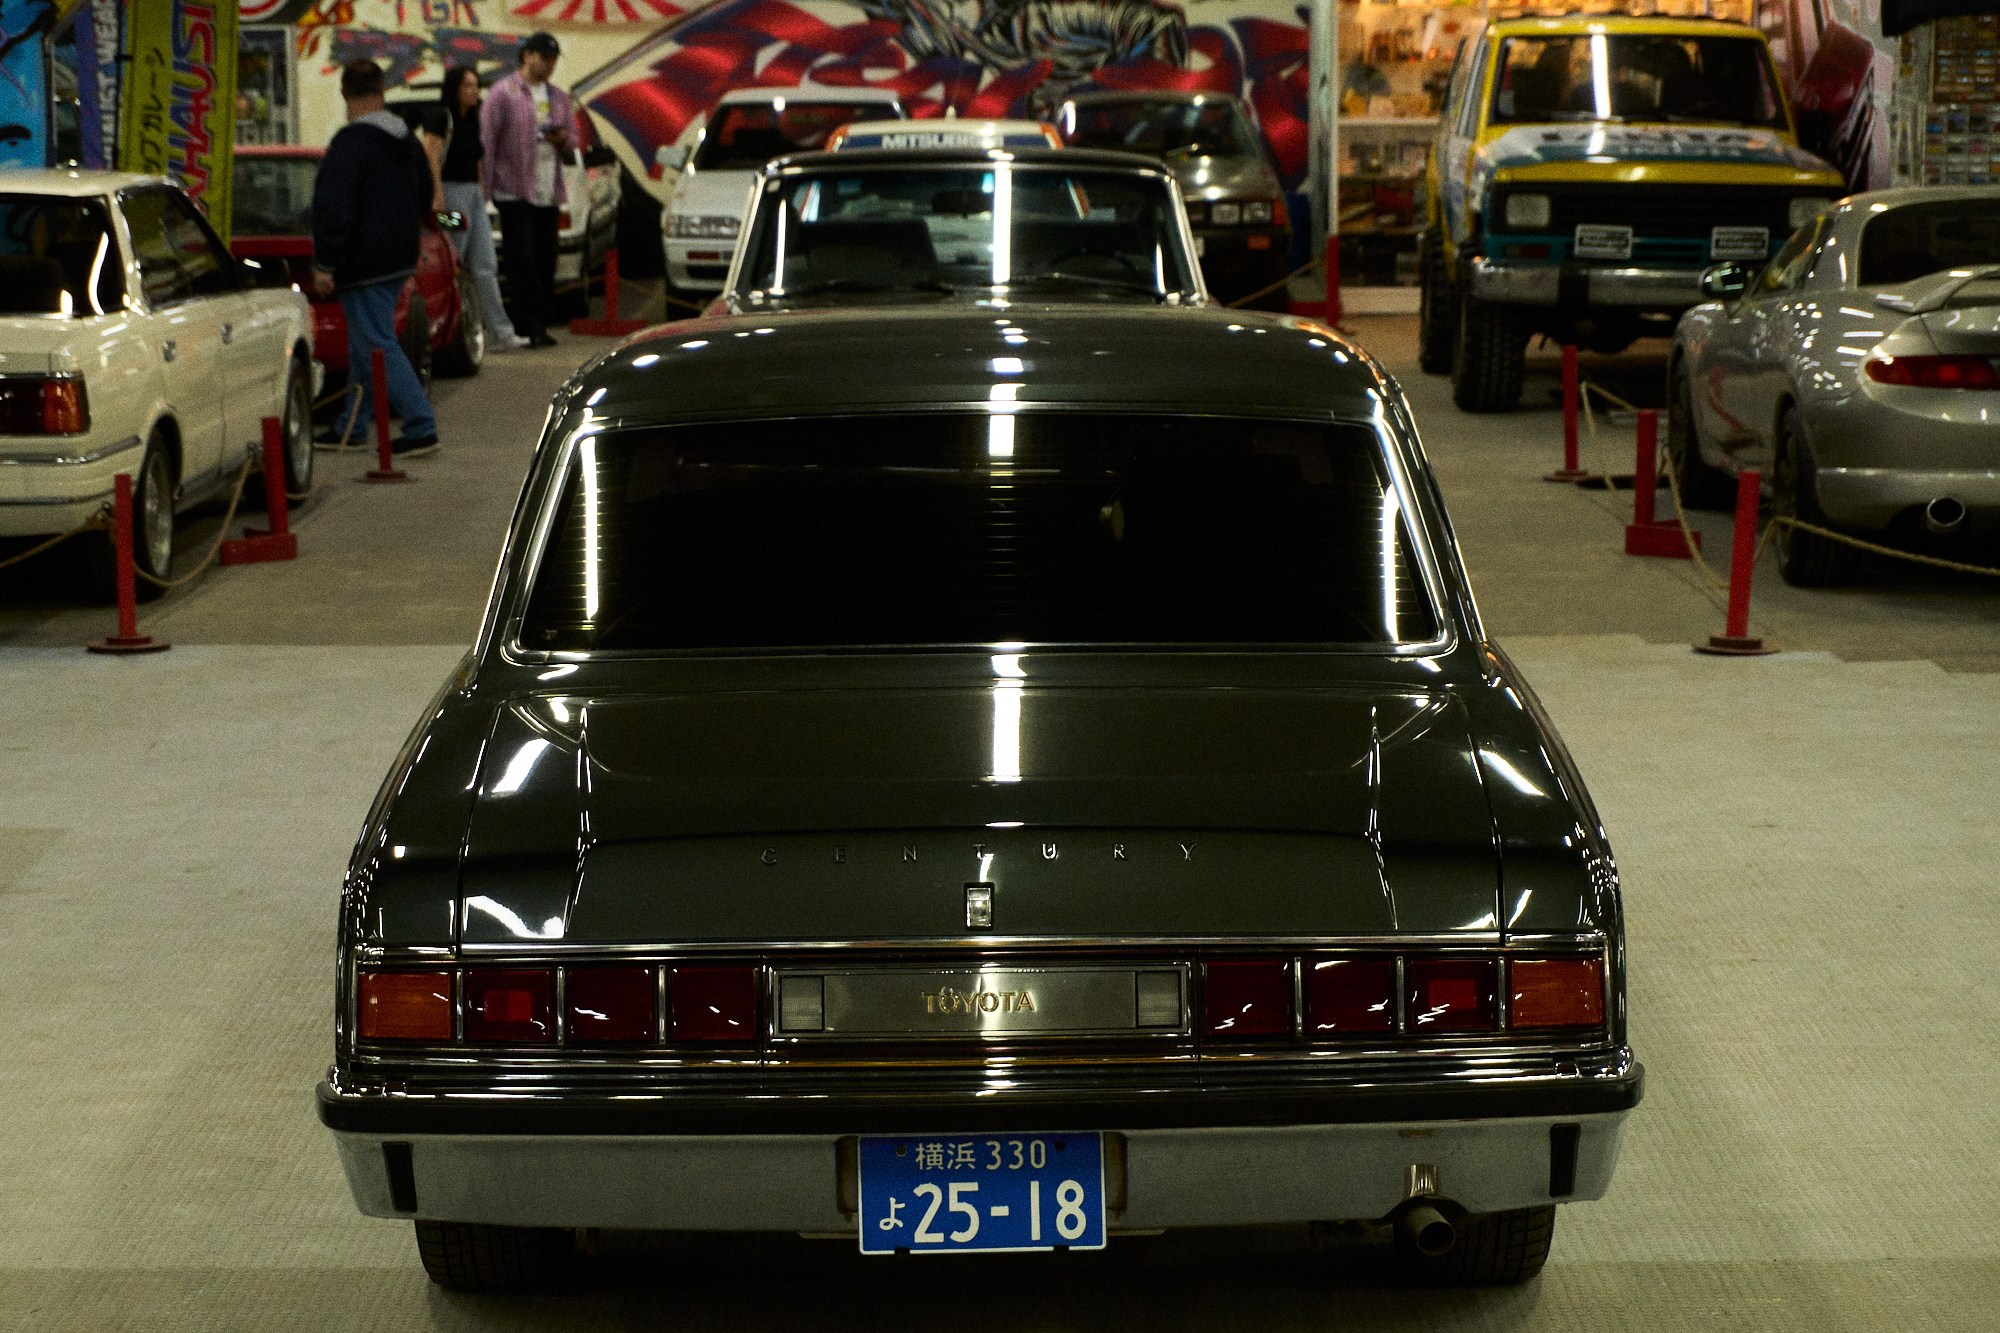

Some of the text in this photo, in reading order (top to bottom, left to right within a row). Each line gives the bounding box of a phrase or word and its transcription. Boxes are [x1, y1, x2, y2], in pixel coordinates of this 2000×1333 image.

[760, 841, 1197, 864] CENTURY
[922, 990, 1037, 1014] TOYOTA
[915, 1139, 1046, 1170] 横浜 330
[879, 1179, 1087, 1243] よ 25-18
